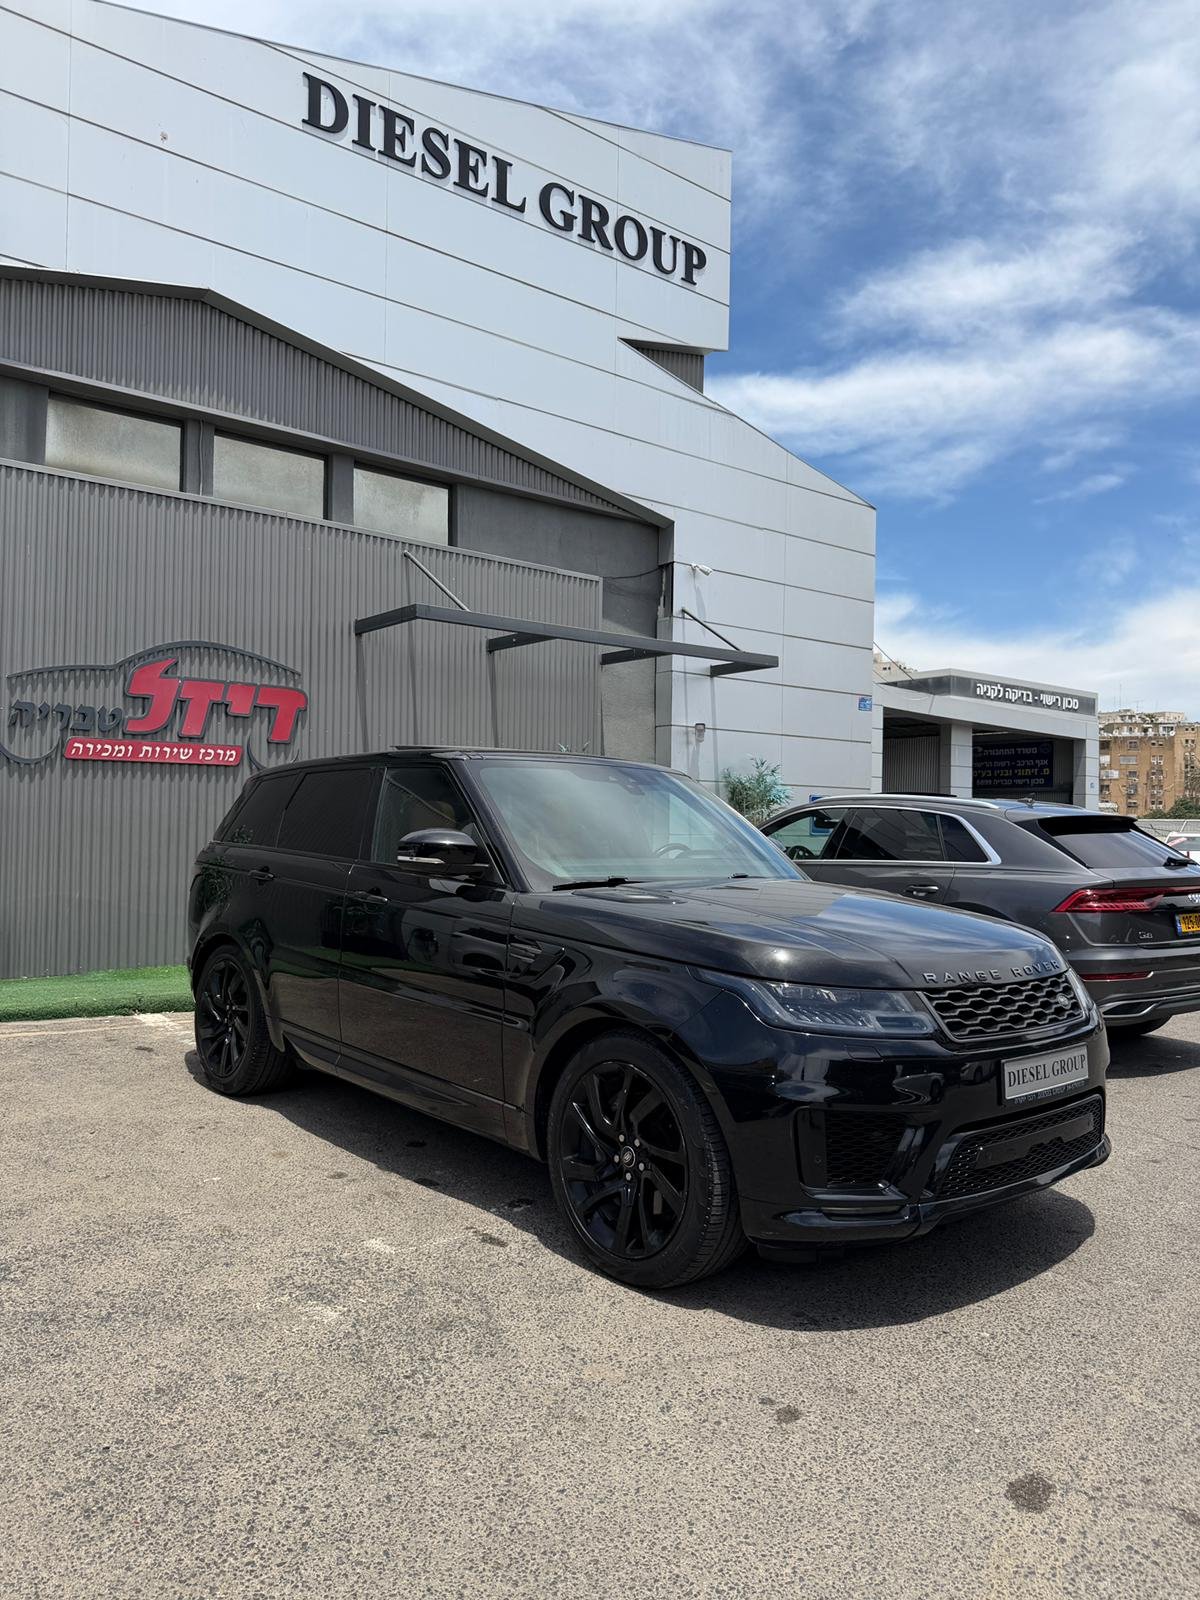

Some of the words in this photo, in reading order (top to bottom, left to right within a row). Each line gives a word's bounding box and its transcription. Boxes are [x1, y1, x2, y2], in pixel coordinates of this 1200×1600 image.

[302, 71, 527, 214] DIESEL
[538, 181, 708, 287] GROUP
[123, 656, 308, 744] דיזל
[976, 683, 1004, 699] לקניה
[1005, 688, 1033, 702] בדיקה
[1040, 693, 1061, 707] רישוי
[7, 699, 125, 732] טבריה
[70, 741, 133, 758] ומכירה
[138, 743, 194, 761] שירות
[199, 744, 237, 762] מרכז
[922, 968, 1002, 984] RANGE
[1010, 959, 1060, 978] ROVER
[1007, 1063, 1050, 1087] DIESEL
[1051, 1054, 1086, 1077] GROUP
